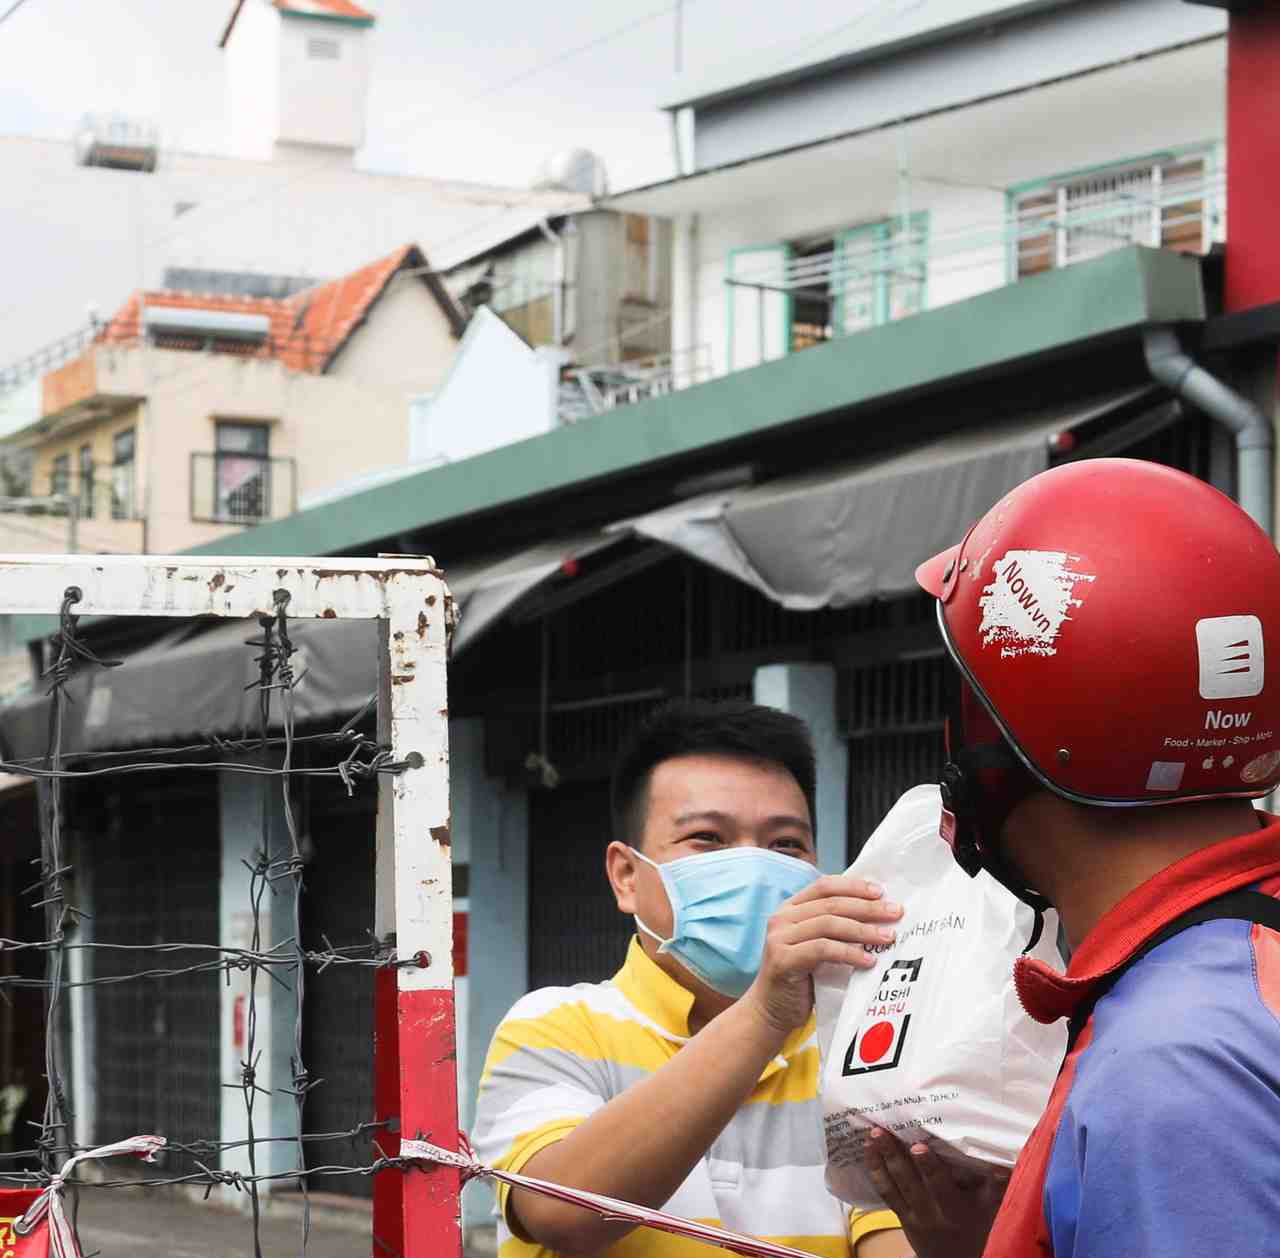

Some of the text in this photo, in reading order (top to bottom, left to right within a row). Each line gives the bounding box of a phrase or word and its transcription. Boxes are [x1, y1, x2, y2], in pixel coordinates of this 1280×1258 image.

[1001, 559, 1051, 634] Now.vn
[1204, 709, 1252, 729] Now
[873, 985, 912, 1002] USHI
[866, 1001, 906, 1017] HARU
